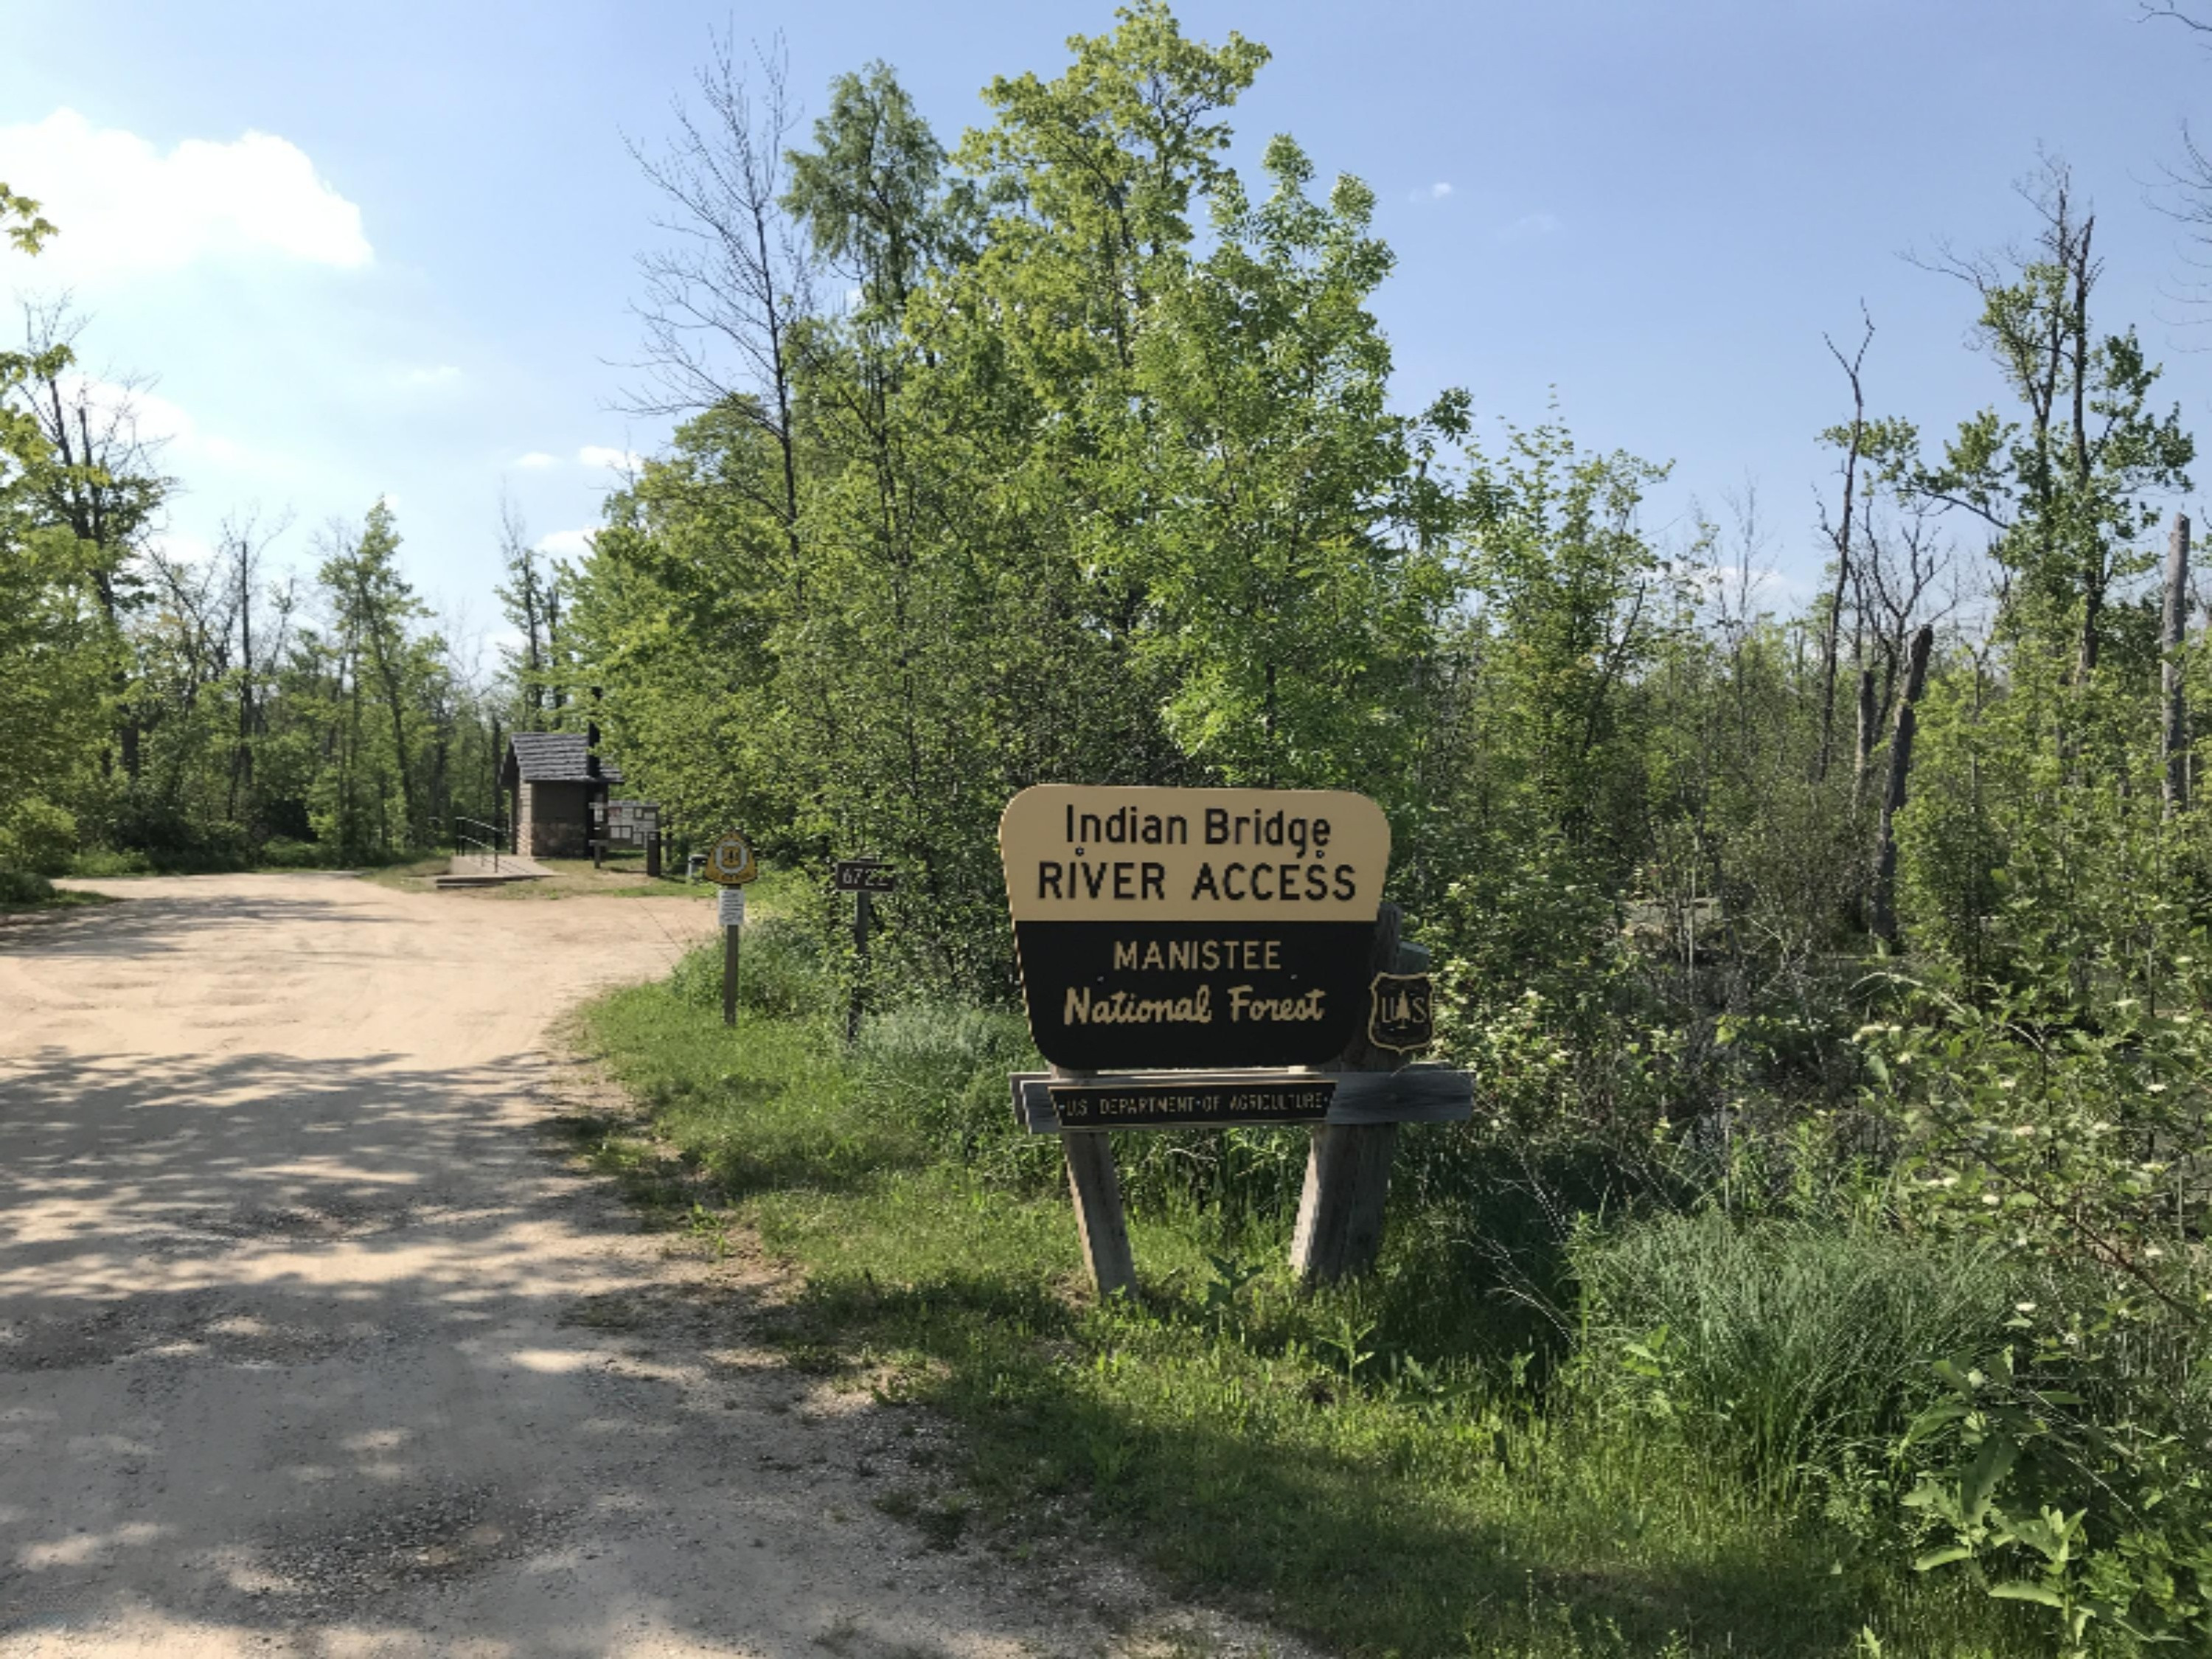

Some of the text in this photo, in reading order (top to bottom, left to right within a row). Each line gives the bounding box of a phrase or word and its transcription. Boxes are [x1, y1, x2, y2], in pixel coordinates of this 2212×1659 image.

[1066, 804, 1330, 858] Indian Bridge
[1038, 860, 1356, 901] RIVER ACCESS
[1113, 940, 1281, 970] MANISTEE
[1064, 984, 1326, 1026] National Forest
[1099, 1096, 1195, 1115] DEPARTMENT
[1202, 1096, 1221, 1112] OF
[1229, 1092, 1323, 1110] AGRICULTURE
